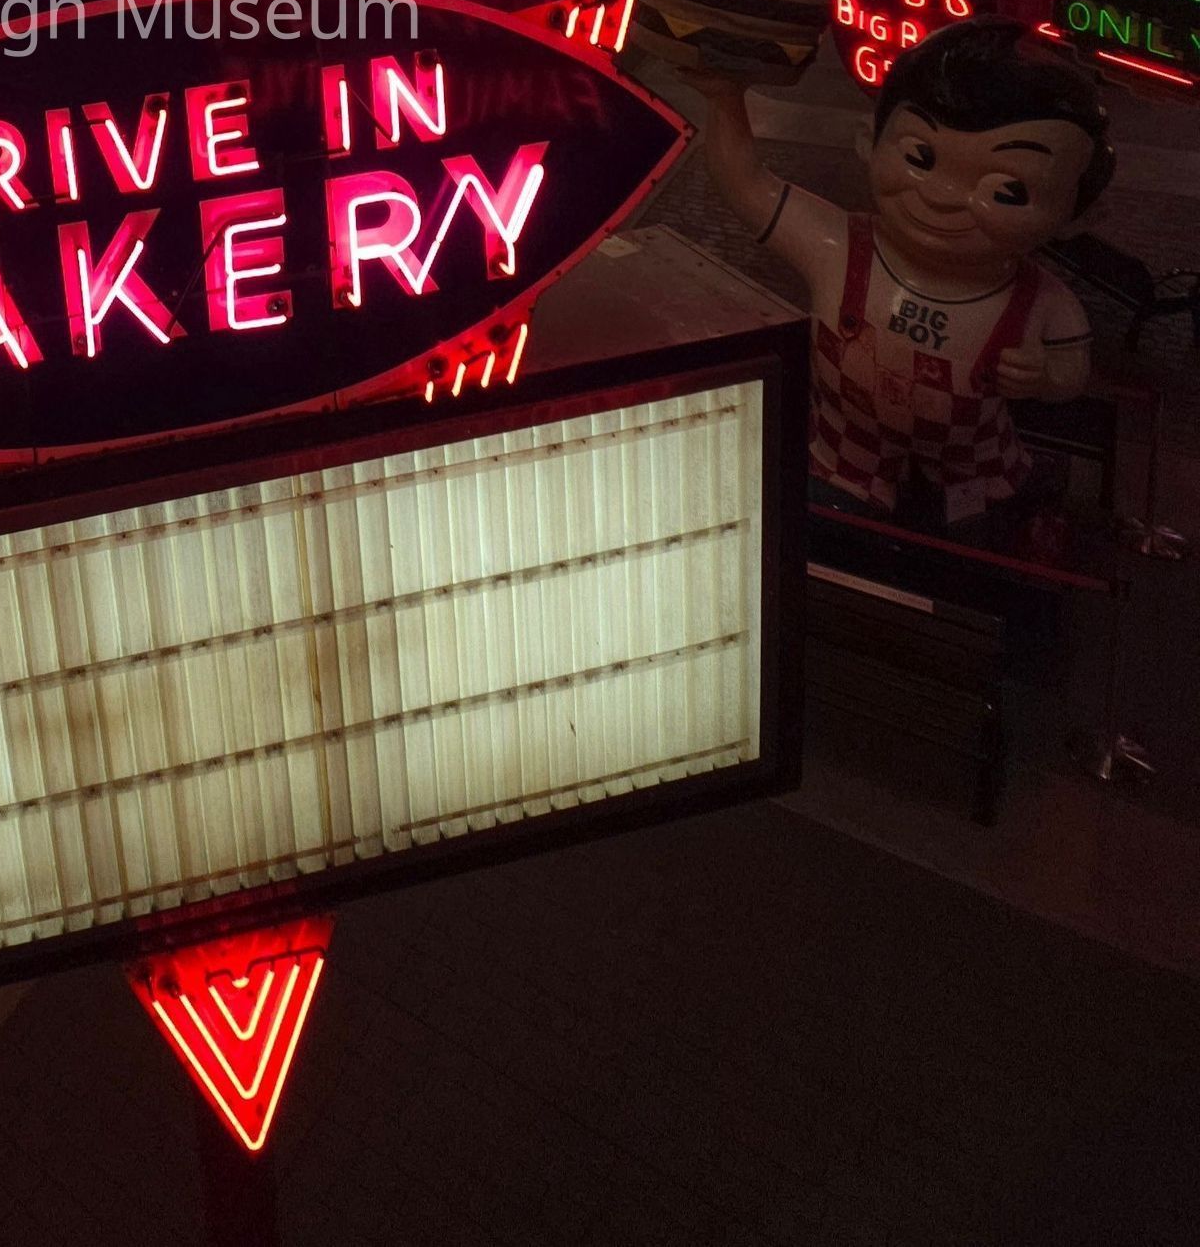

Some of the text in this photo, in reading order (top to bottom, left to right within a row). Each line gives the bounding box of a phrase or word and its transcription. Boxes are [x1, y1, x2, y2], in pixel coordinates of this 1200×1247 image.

[321, 49, 449, 159] IN
[888, 313, 950, 351] BOY
[899, 299, 949, 331] BIG
